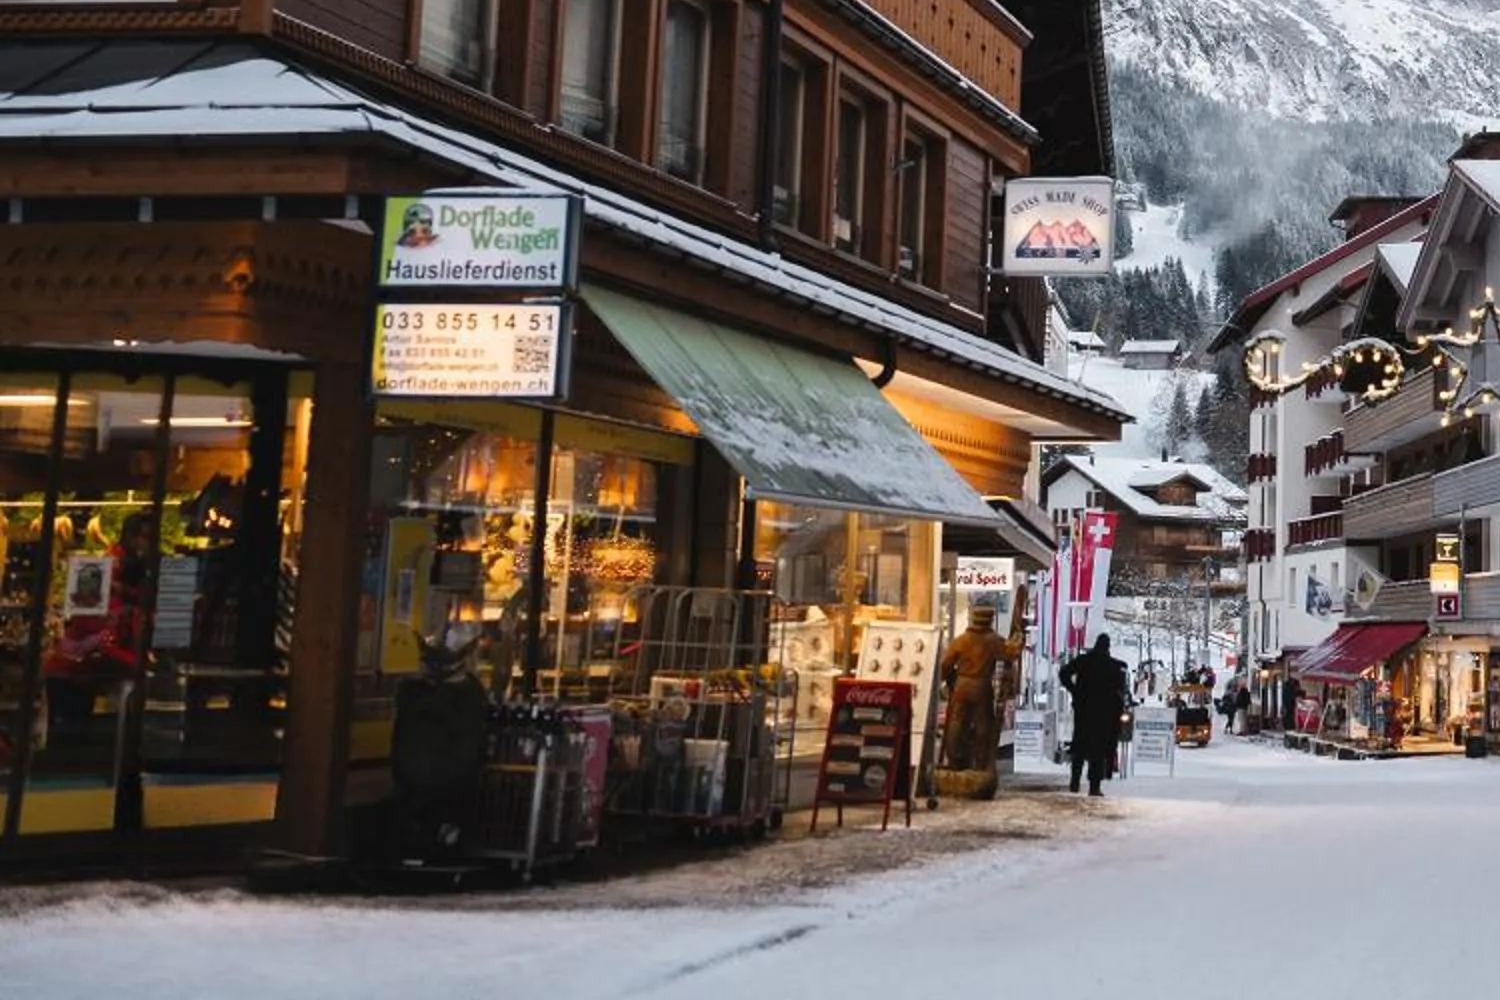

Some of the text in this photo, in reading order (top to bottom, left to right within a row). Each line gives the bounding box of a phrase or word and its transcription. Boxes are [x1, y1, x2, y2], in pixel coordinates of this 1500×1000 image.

[440, 205, 535, 228] Dorflade
[471, 228, 560, 254] Wengen
[386, 259, 557, 280] Hauslieferdienst
[383, 312, 554, 331] 033 855 14 51
[975, 571, 1007, 587] Sport
